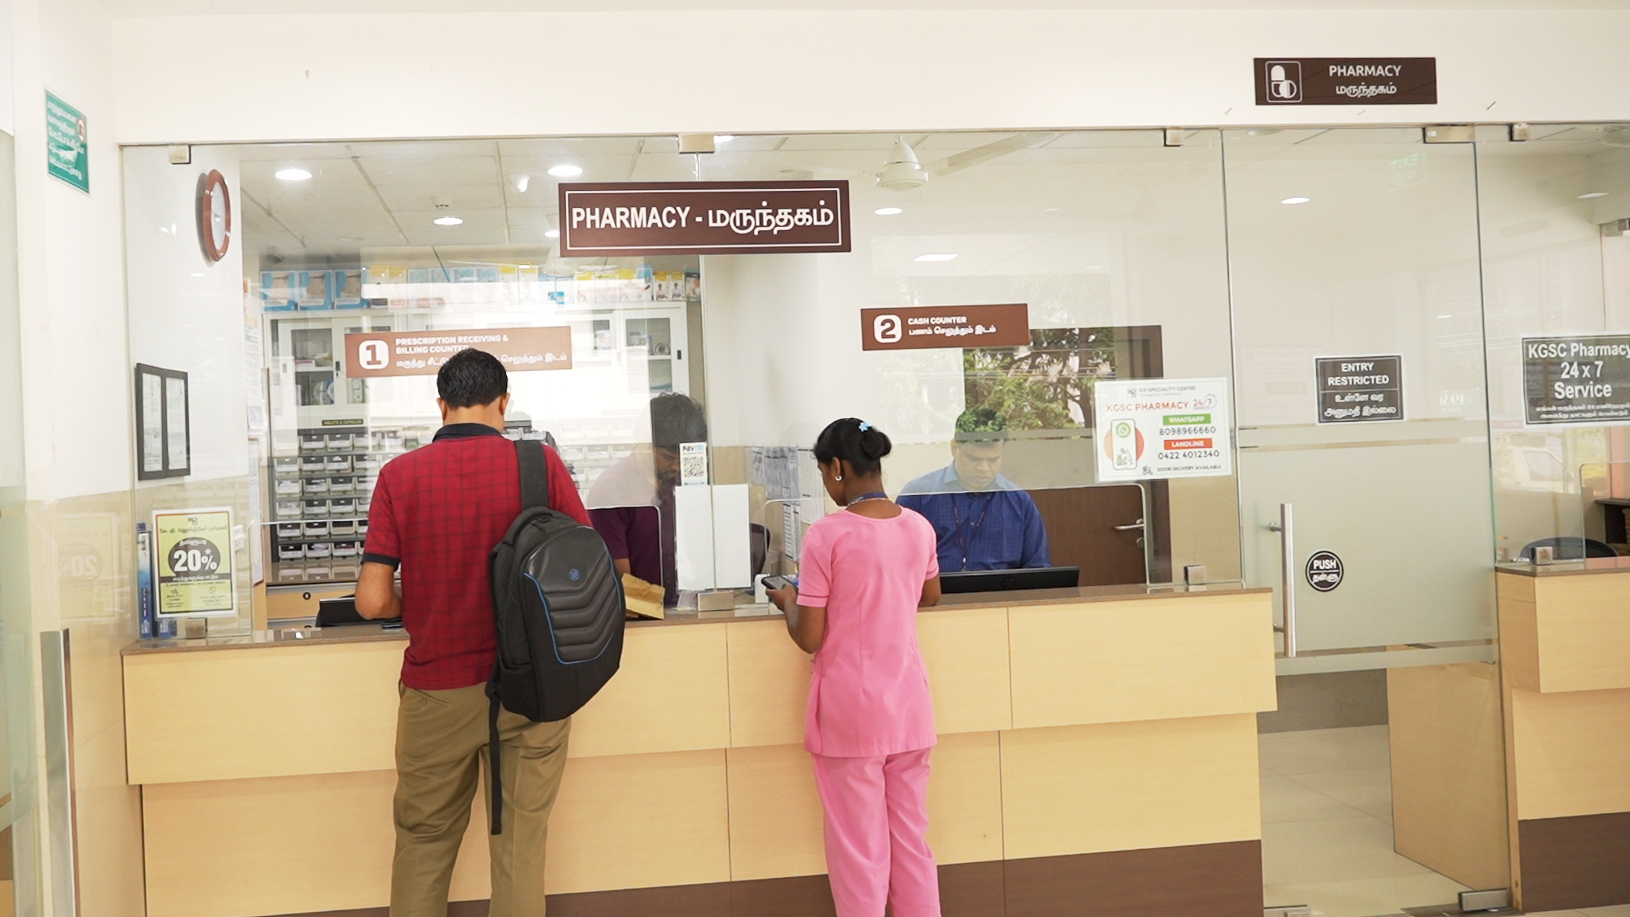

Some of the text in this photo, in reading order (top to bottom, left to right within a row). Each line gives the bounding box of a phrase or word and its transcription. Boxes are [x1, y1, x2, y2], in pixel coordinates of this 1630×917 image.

[1329, 65, 1402, 77] PHARMACY
[1336, 82, 1397, 98] மருந்தகம்
[572, 206, 690, 229] PHARMACY
[708, 200, 834, 235] மருந்தகம்
[907, 316, 967, 325] CASH COUNTER
[974, 324, 997, 335] இடம்
[395, 334, 509, 346] PRESCRIPTION RECEIVING &
[395, 345, 429, 355] BILLING
[1528, 342, 1630, 358] KGSC Pharmacy
[545, 352, 568, 363] இடம்
[1341, 362, 1374, 372] ENTRY
[1560, 360, 1603, 379] 24 x 7
[1327, 375, 1390, 386] RESTRICTED
[1554, 381, 1612, 399] Service
[1106, 401, 1189, 412] KGSC PHARMACY
[1324, 405, 1396, 418] அனுமதி இல்லை
[1168, 415, 1206, 423] WHATSAPP
[1157, 450, 1220, 460] 0422 4012340
[1313, 559, 1337, 570] PUSH
